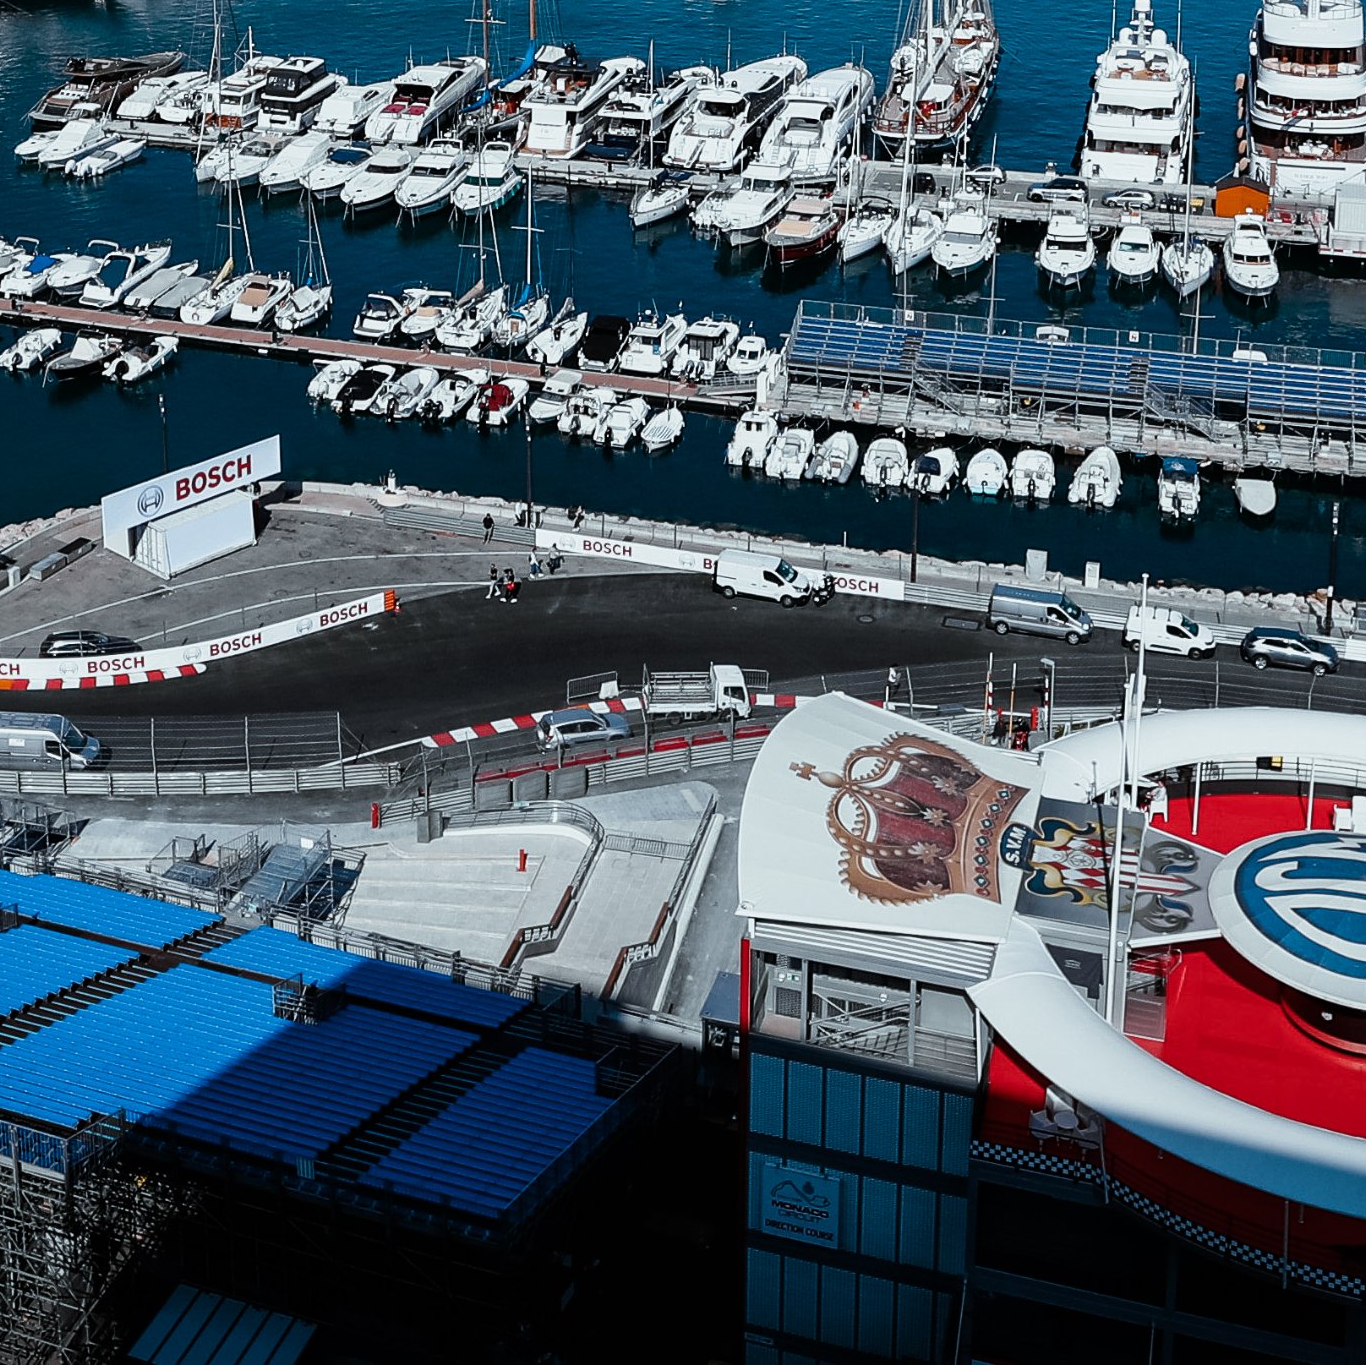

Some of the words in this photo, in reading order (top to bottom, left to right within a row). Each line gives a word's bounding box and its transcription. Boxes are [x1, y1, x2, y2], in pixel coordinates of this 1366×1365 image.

[176, 454, 252, 501] BOSCH
[583, 540, 632, 557] BOSCH
[831, 577, 879, 593] OSCH
[87, 656, 145, 673] BOSCH
[210, 632, 262, 656] BOSCH
[320, 602, 368, 627] BOSCH
[765, 1218, 804, 1233] DIRECTION
[805, 1227, 834, 1241] COURSE
[771, 1200, 829, 1219] MONACO
